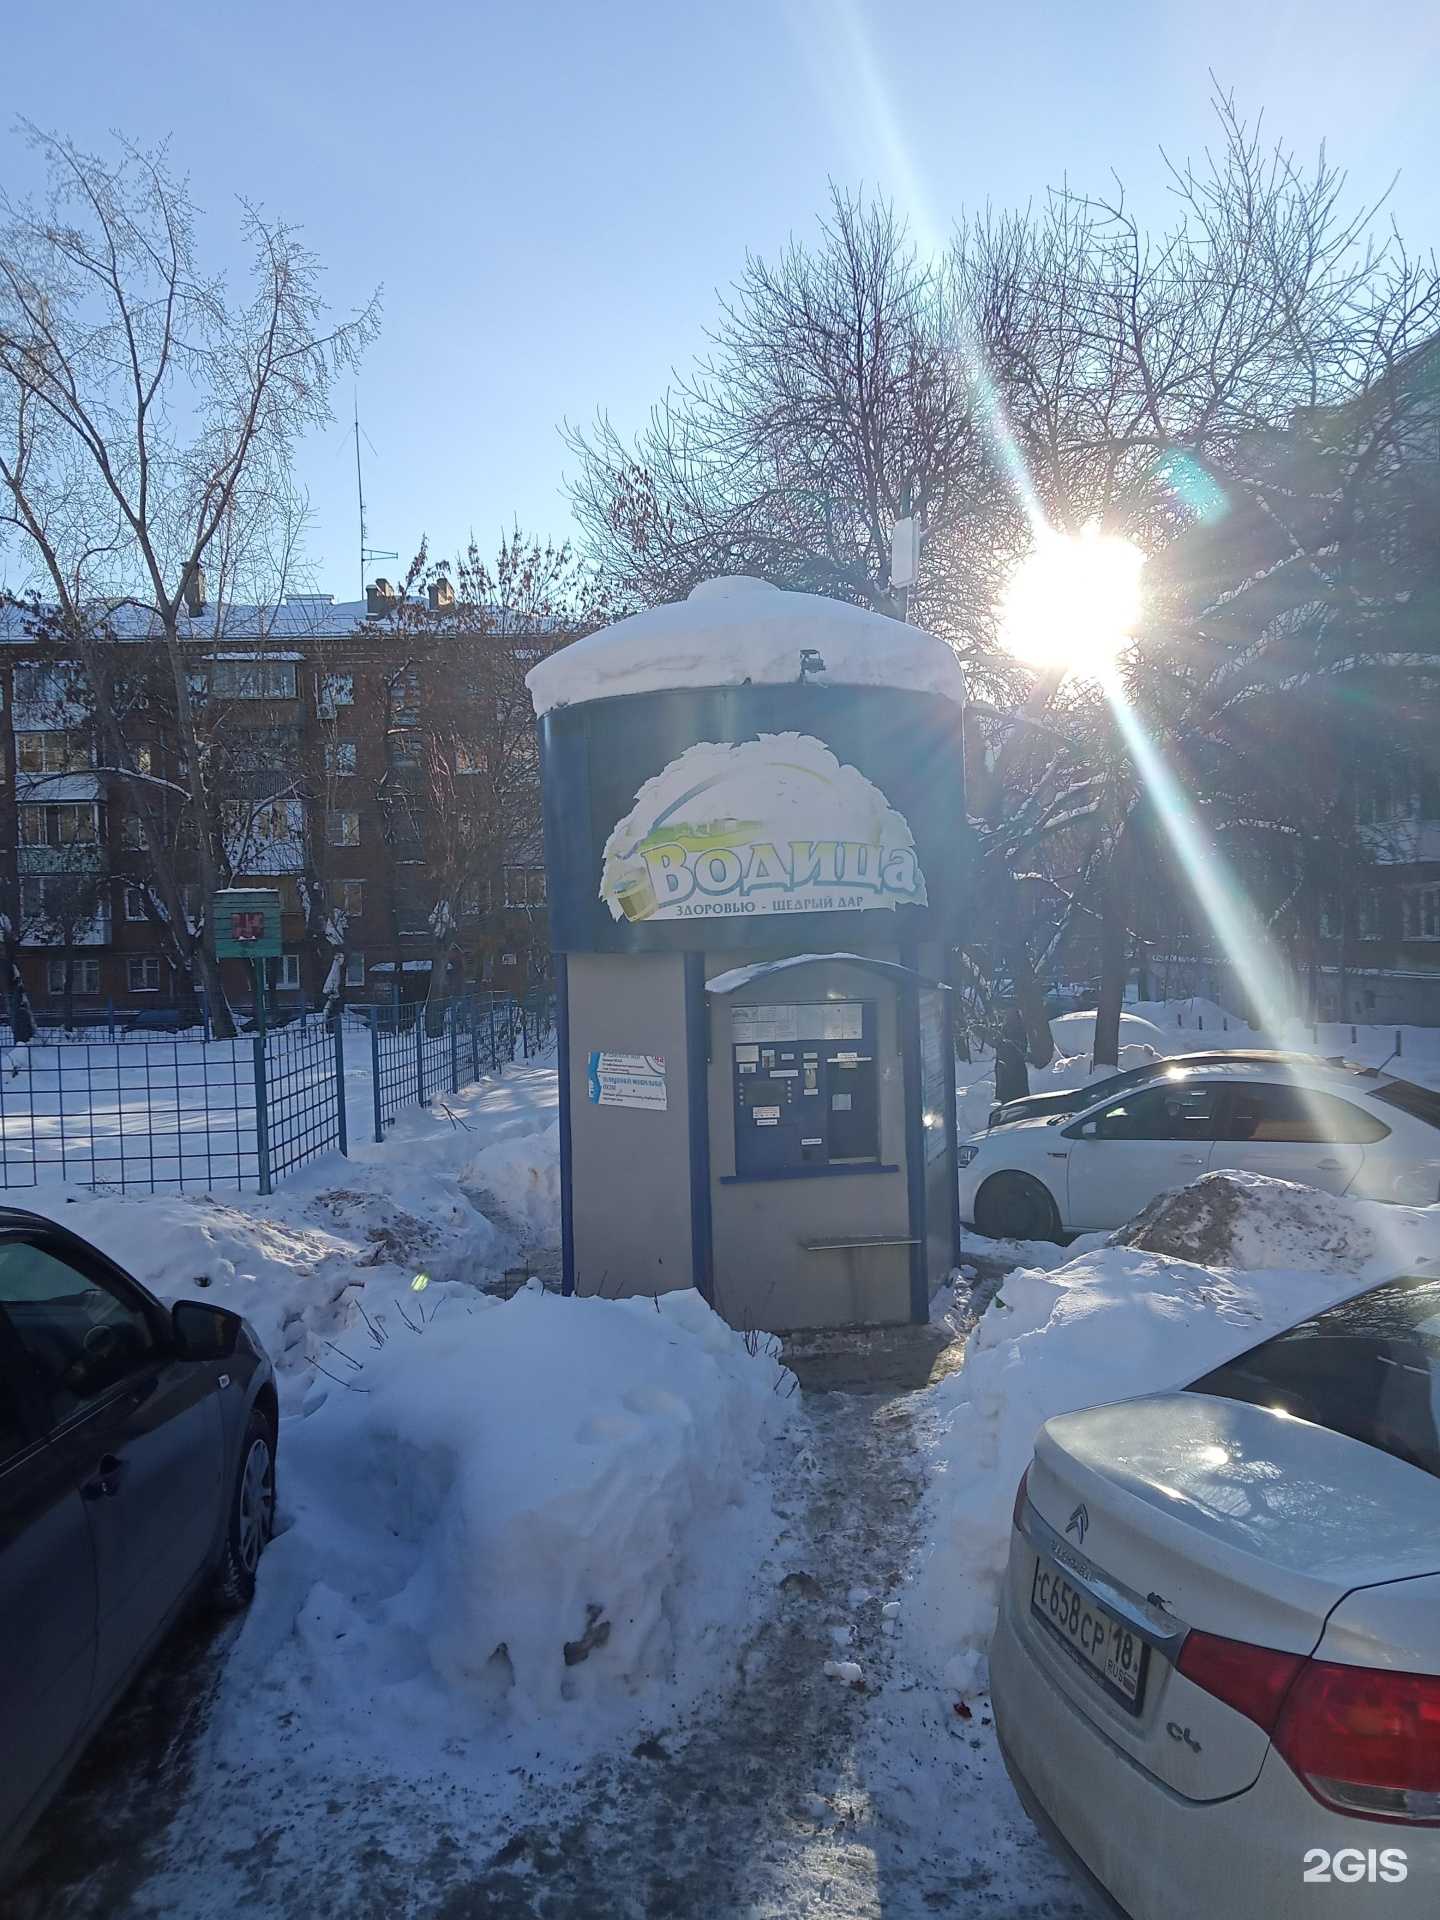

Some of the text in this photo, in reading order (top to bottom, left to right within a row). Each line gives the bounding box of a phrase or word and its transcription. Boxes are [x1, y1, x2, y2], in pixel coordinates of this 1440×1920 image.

[677, 903, 755, 916] ЗДОРОВЬЮ
[772, 896, 832, 912] ЩЕДРЫЙ
[838, 896, 863, 908] ДАР
[1110, 1625, 1133, 1670] 18
[1107, 1659, 1124, 1682] RUS
[1166, 1722, 1202, 1753] C4
